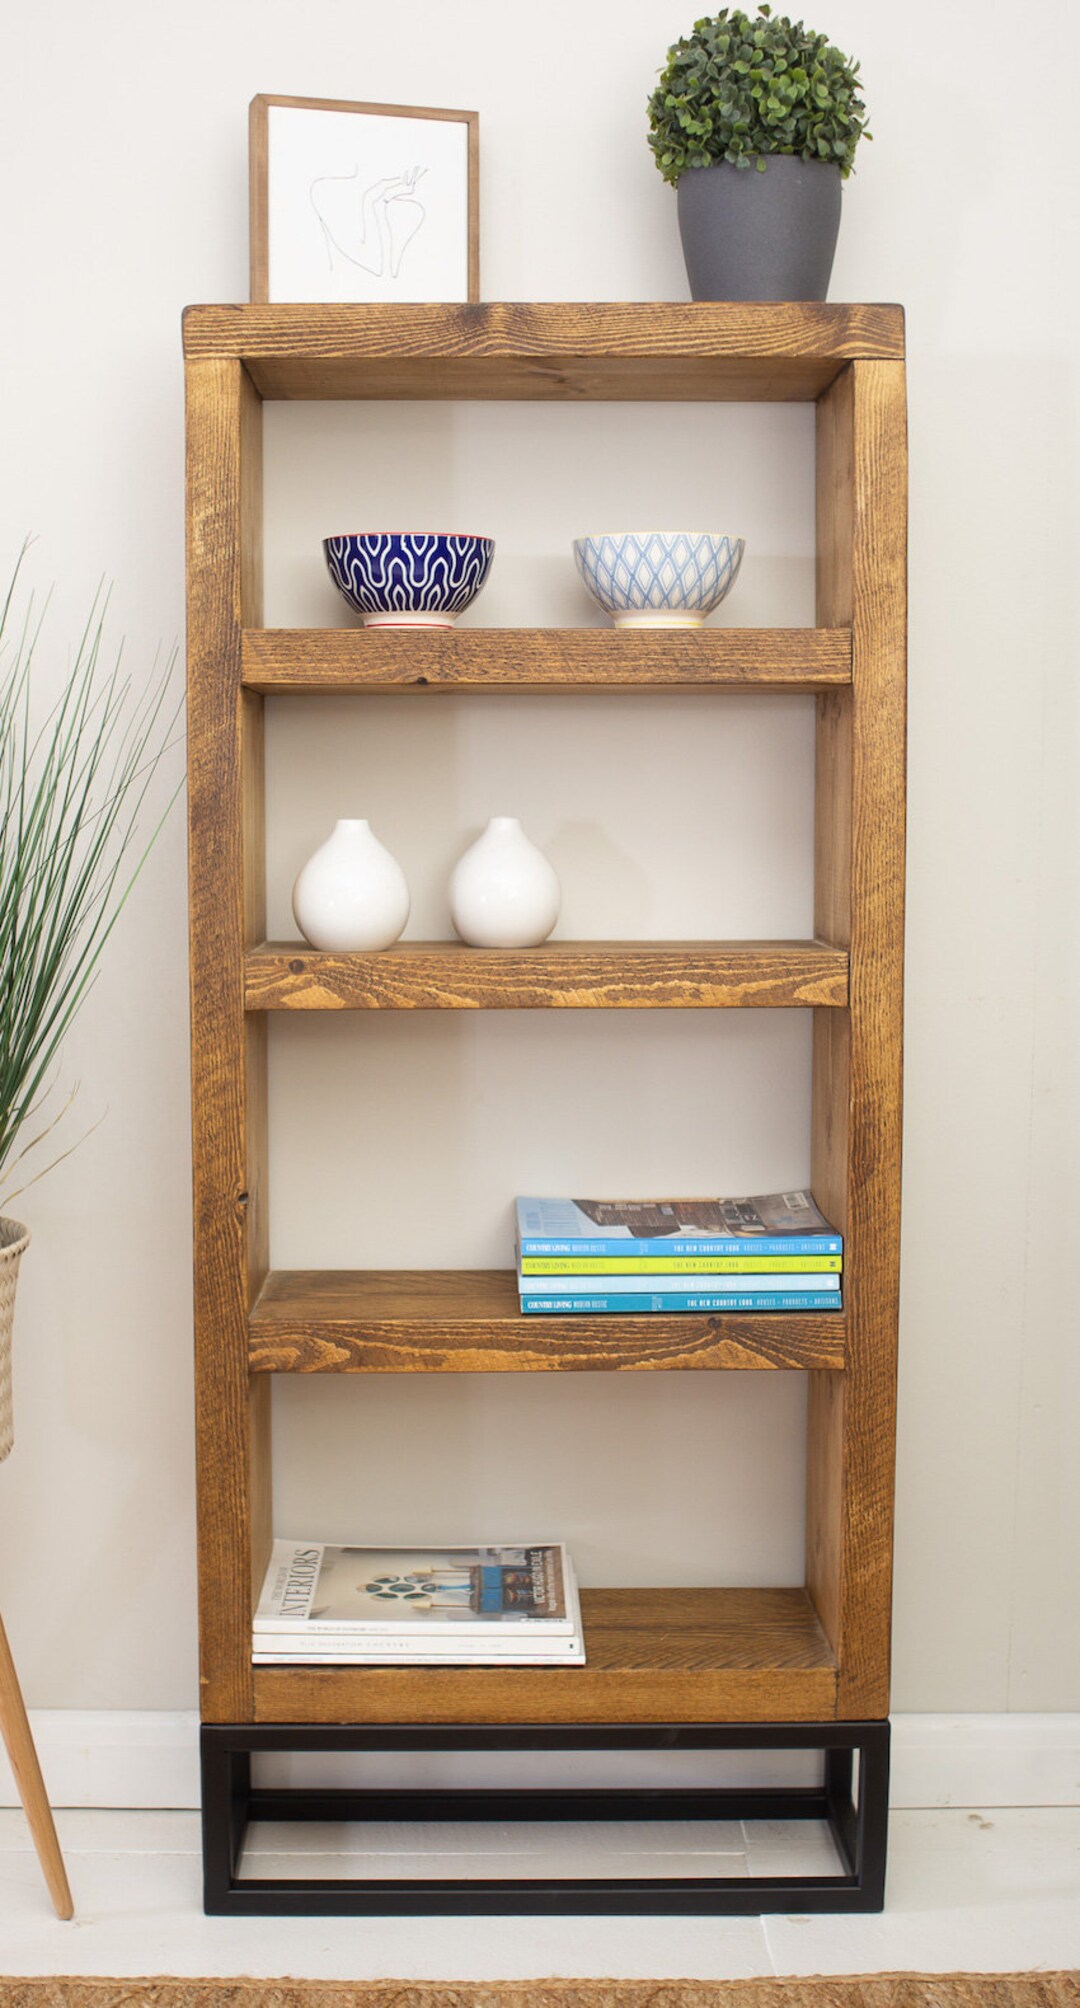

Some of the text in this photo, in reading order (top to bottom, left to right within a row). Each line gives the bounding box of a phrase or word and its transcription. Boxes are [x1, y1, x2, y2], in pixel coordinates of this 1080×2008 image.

[526, 1244, 551, 1252] COUNTRY
[552, 1244, 570, 1252] LIVING
[673, 1244, 684, 1252] THE
[685, 1244, 697, 1252] NEW
[699, 1244, 724, 1252] COUNTRY
[725, 1244, 740, 1252] LOOK
[553, 1300, 572, 1308] LIVING
[738, 1298, 753, 1306] LOOK
[279, 1549, 320, 1617] INTERIORS
